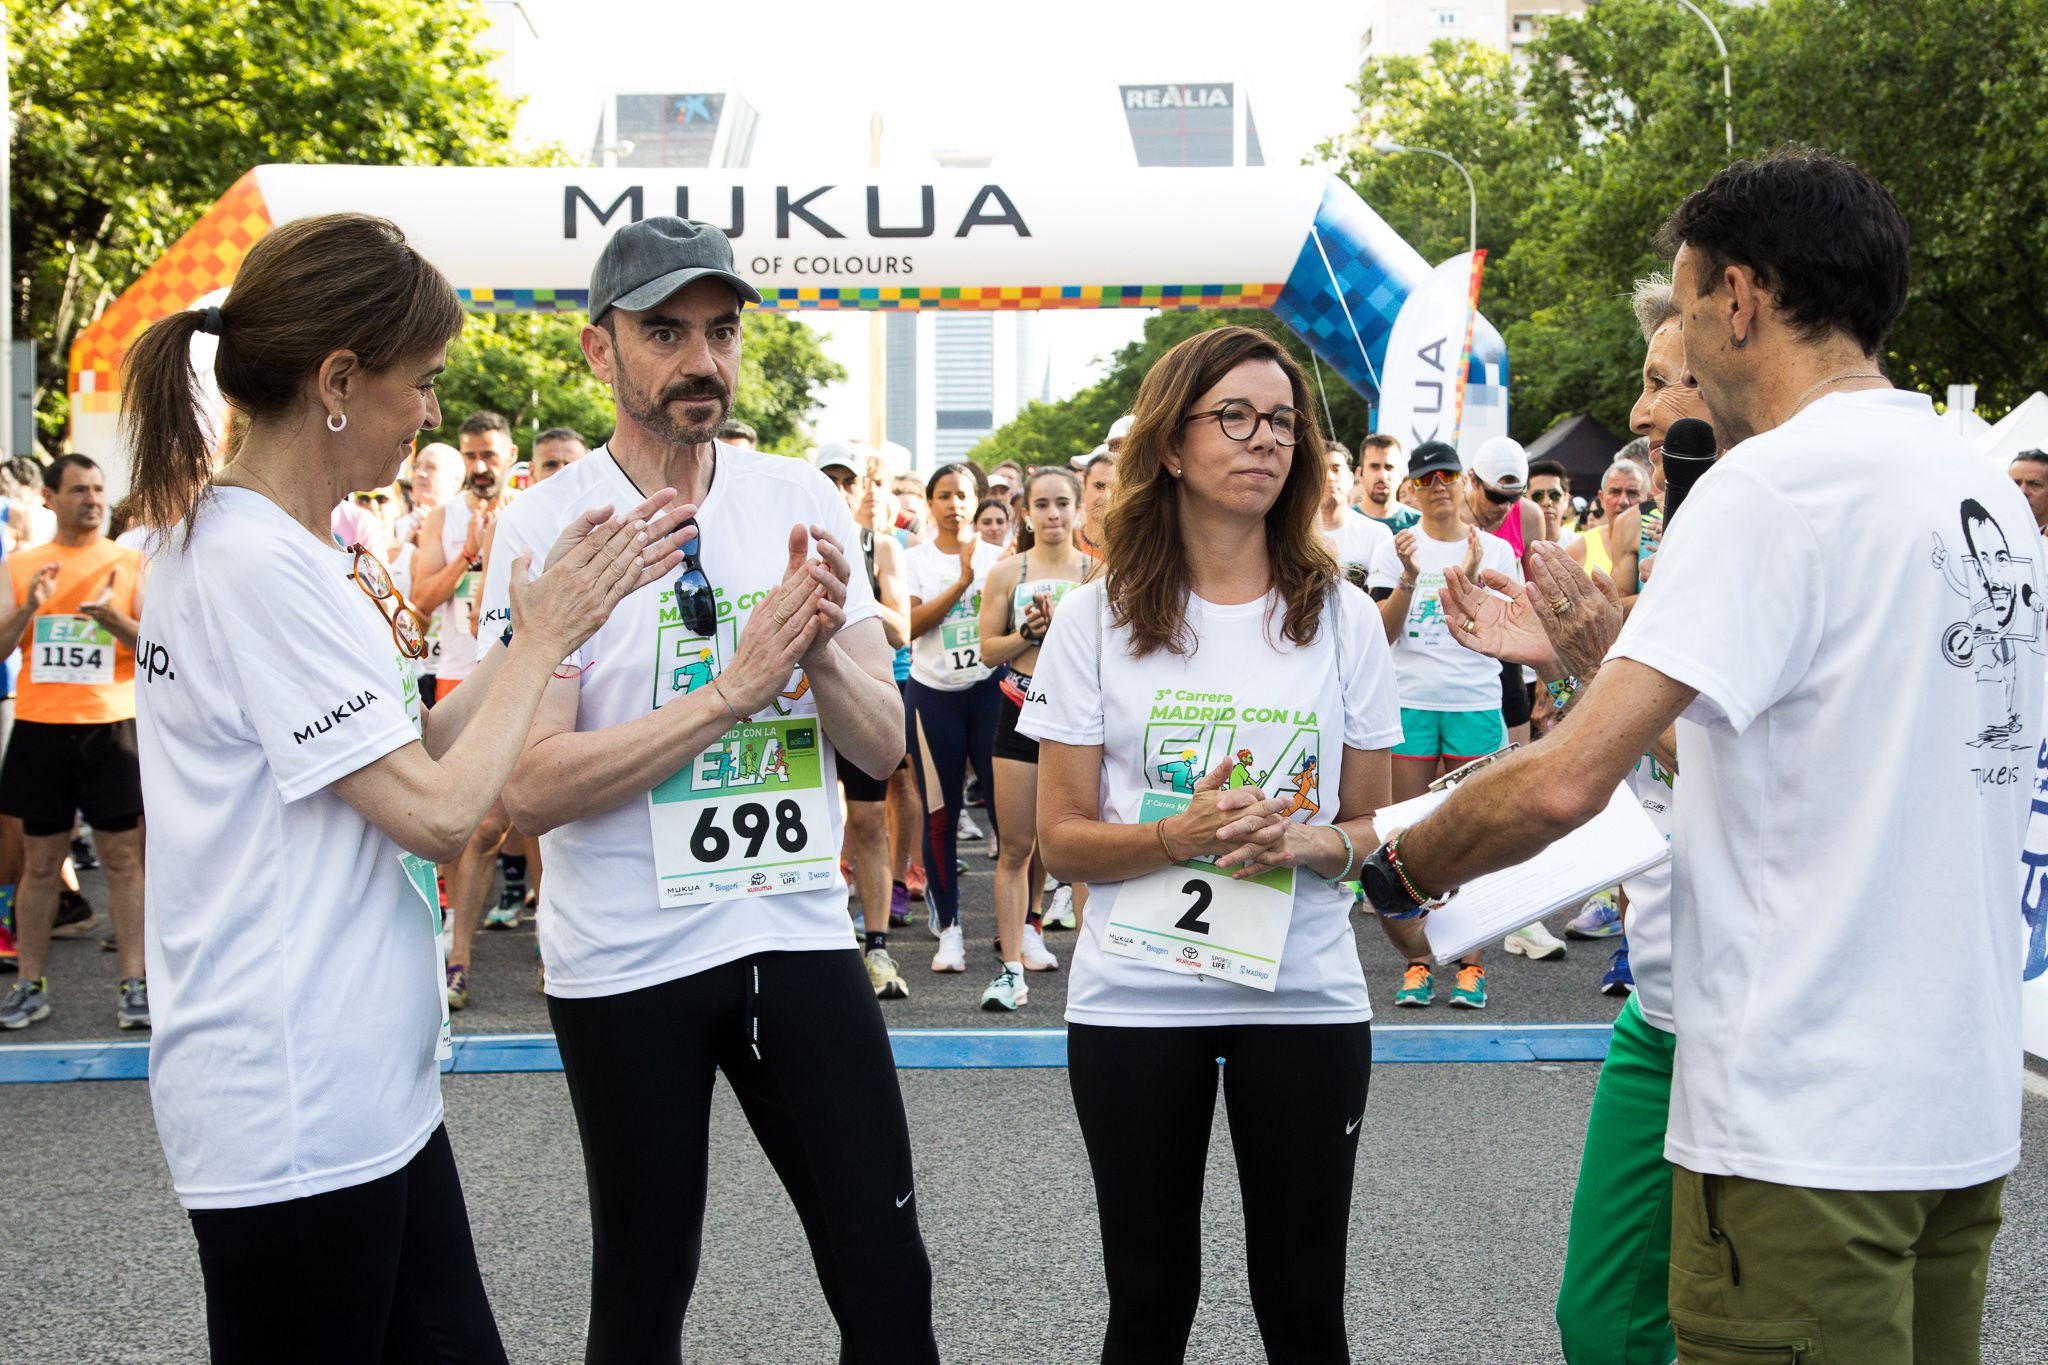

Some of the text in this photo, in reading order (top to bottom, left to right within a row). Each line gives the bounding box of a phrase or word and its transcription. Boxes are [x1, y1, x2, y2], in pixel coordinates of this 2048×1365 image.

[563, 184, 1032, 240] MUKUA
[752, 256, 913, 274] OF COLOURS
[42, 647, 102, 669] 1154
[1175, 689, 1233, 703] Carrera
[293, 690, 378, 744] MUKUA
[1149, 705, 1319, 727] MADRID CON LA
[743, 728, 762, 738] CON
[764, 727, 777, 736] LA
[690, 737, 790, 792] ELA
[690, 799, 808, 863] 698
[667, 884, 701, 894] MUKUA
[783, 877, 796, 885] LIFE
[1174, 879, 1213, 935] 2
[1109, 934, 1134, 944] MUKUA
[1146, 944, 1169, 955] Biogen
[1212, 961, 1225, 970] LIFE
[1246, 968, 1269, 980] MADRID
